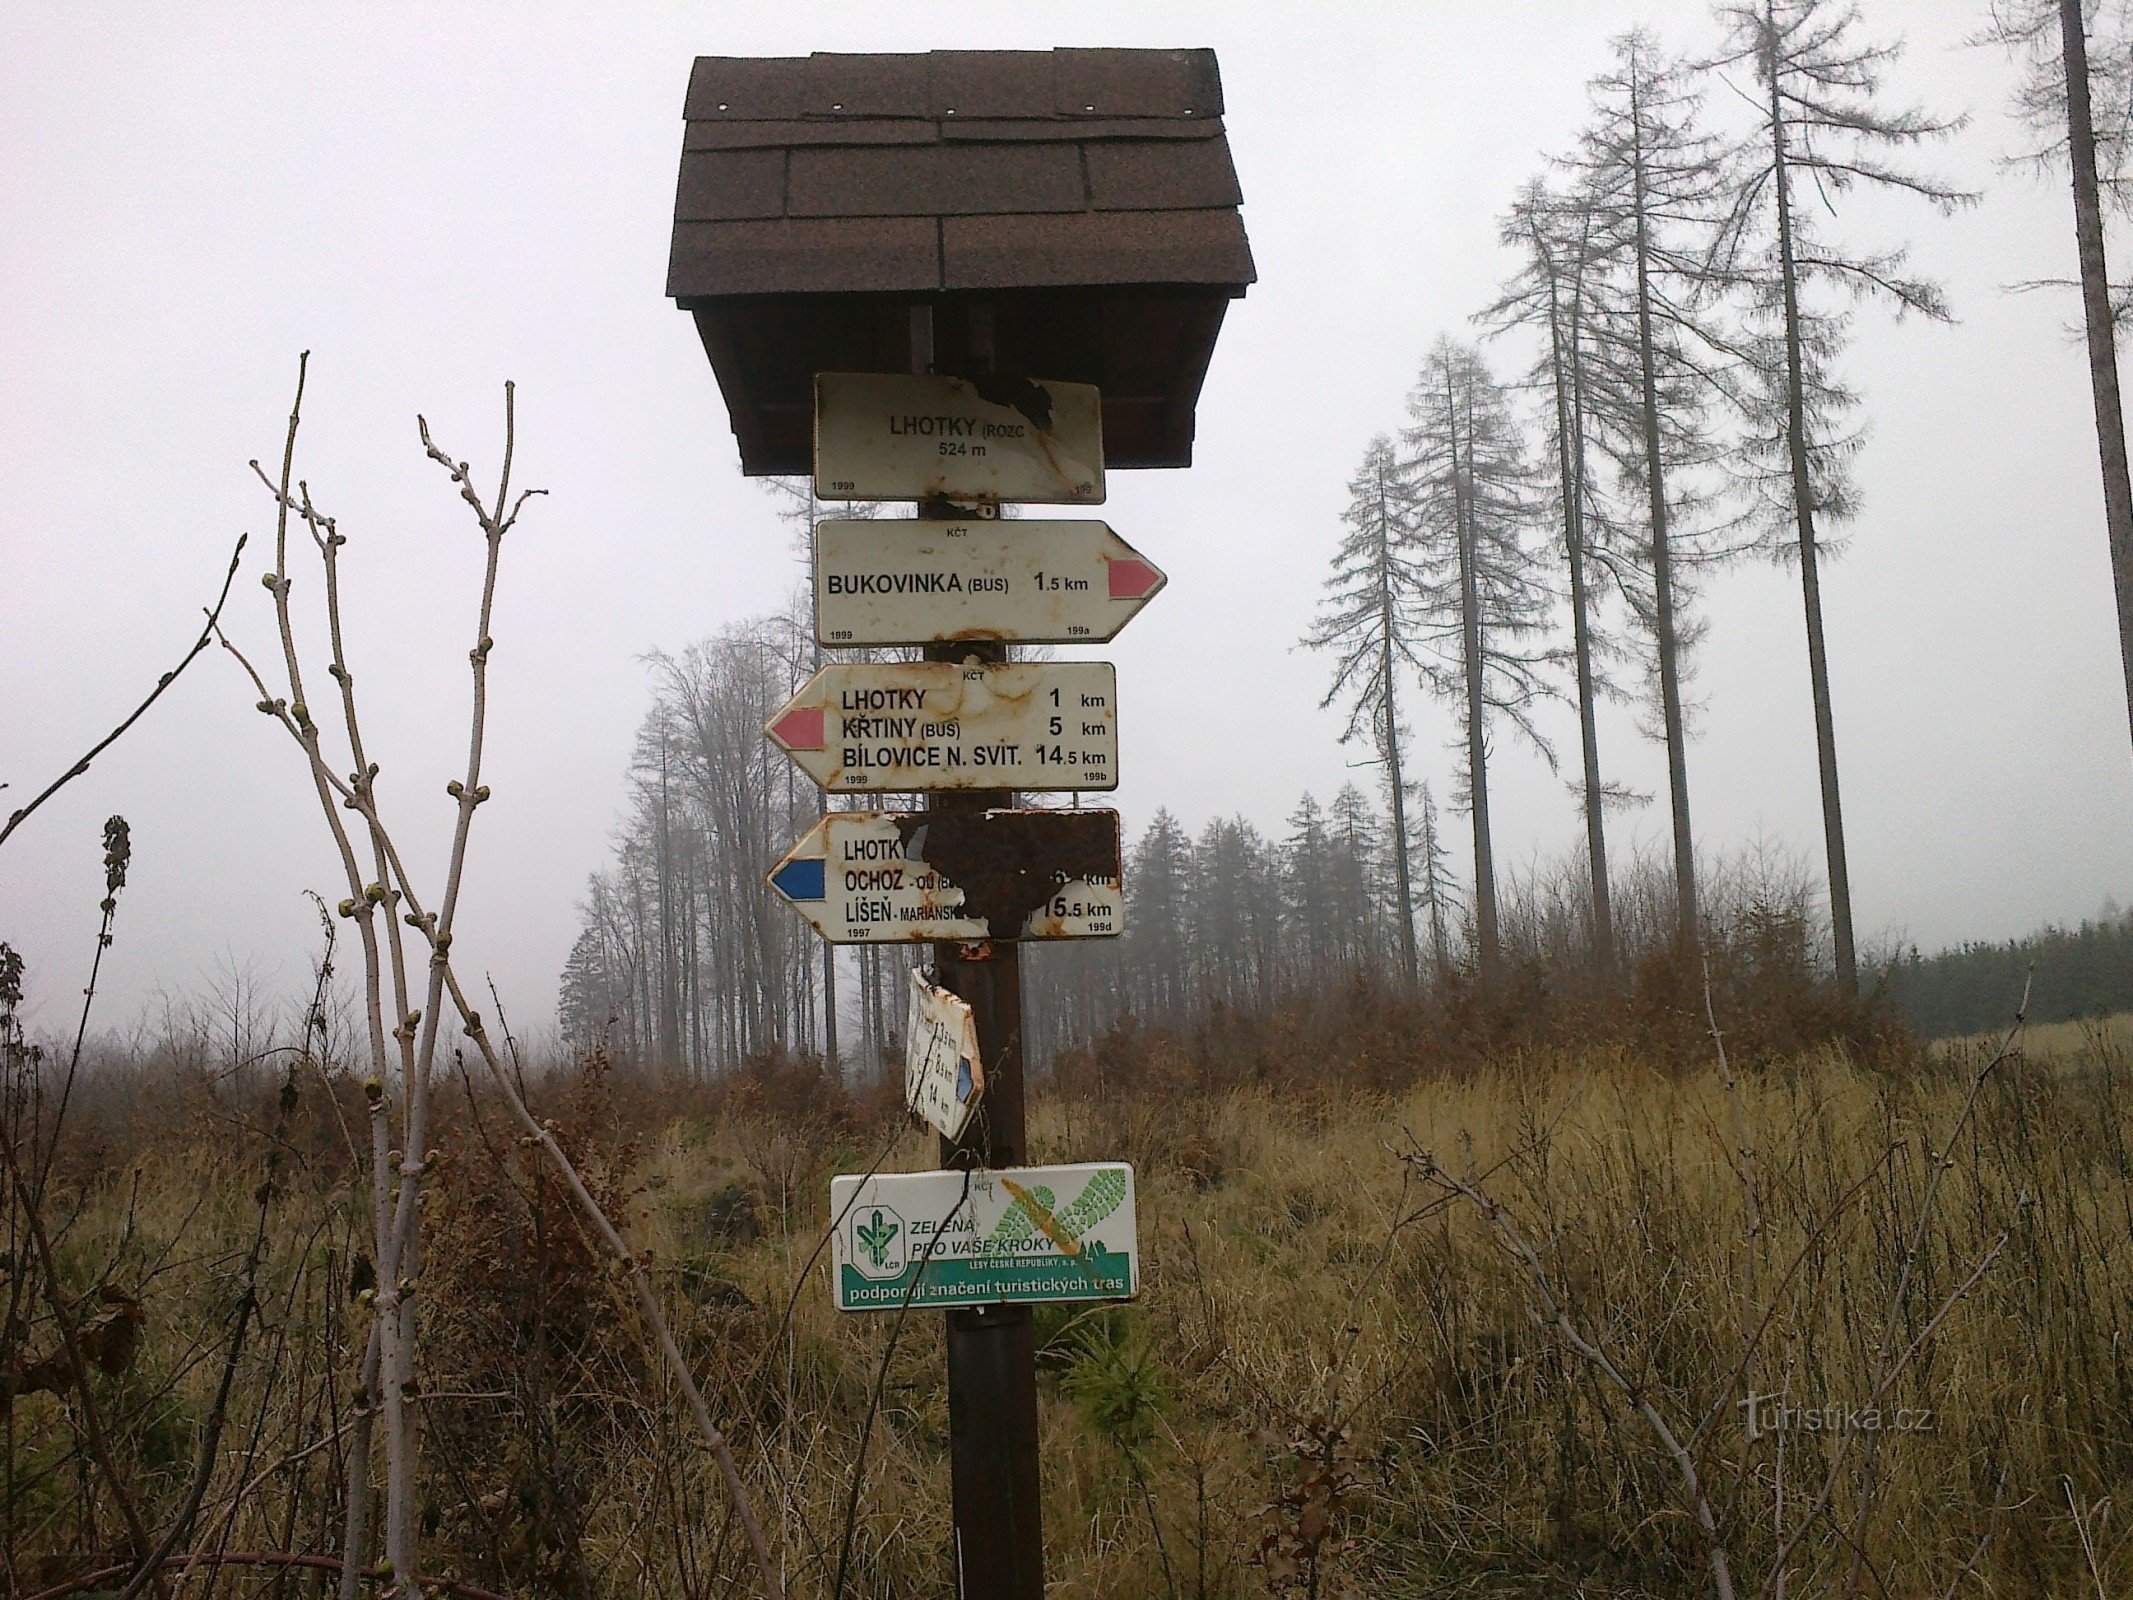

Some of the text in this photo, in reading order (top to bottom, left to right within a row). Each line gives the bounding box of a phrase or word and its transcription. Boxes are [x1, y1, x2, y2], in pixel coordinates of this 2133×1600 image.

[891, 415, 1025, 440] LHOTKY (ROZC
[939, 442, 986, 456] 524 m
[832, 482, 855, 491] 1999
[947, 528, 967, 538] KČT
[827, 572, 1089, 596] BUKOVINKA (BUS) 1.5 km
[830, 631, 853, 640] 1999
[1067, 626, 1090, 635] 199a
[842, 688, 1105, 710] LHOTKY 1 km
[843, 715, 1106, 741] KŘTINY (BUS) 5 km
[843, 744, 941, 768] BÍLOVICE
[947, 746, 967, 766] N.
[1036, 746, 1077, 765] 14.5
[1082, 751, 1106, 765] km
[845, 776, 868, 785] 1999
[1084, 772, 1107, 782] 199b
[844, 839, 908, 861] LHOTKY
[845, 870, 904, 892] OCHOZ
[846, 895, 892, 922] LÍŠEŇ
[1087, 902, 1112, 916] km
[847, 928, 871, 937] 1997
[1088, 922, 1112, 932] 199d
[951, 1236, 993, 1255] VAŠE
[997, 1237, 1056, 1252] KROKY
[969, 1260, 988, 1270] LESY
[850, 1284, 927, 1302] podporjí
[929, 1281, 991, 1297] značení
[994, 1275, 1088, 1294] turistických
